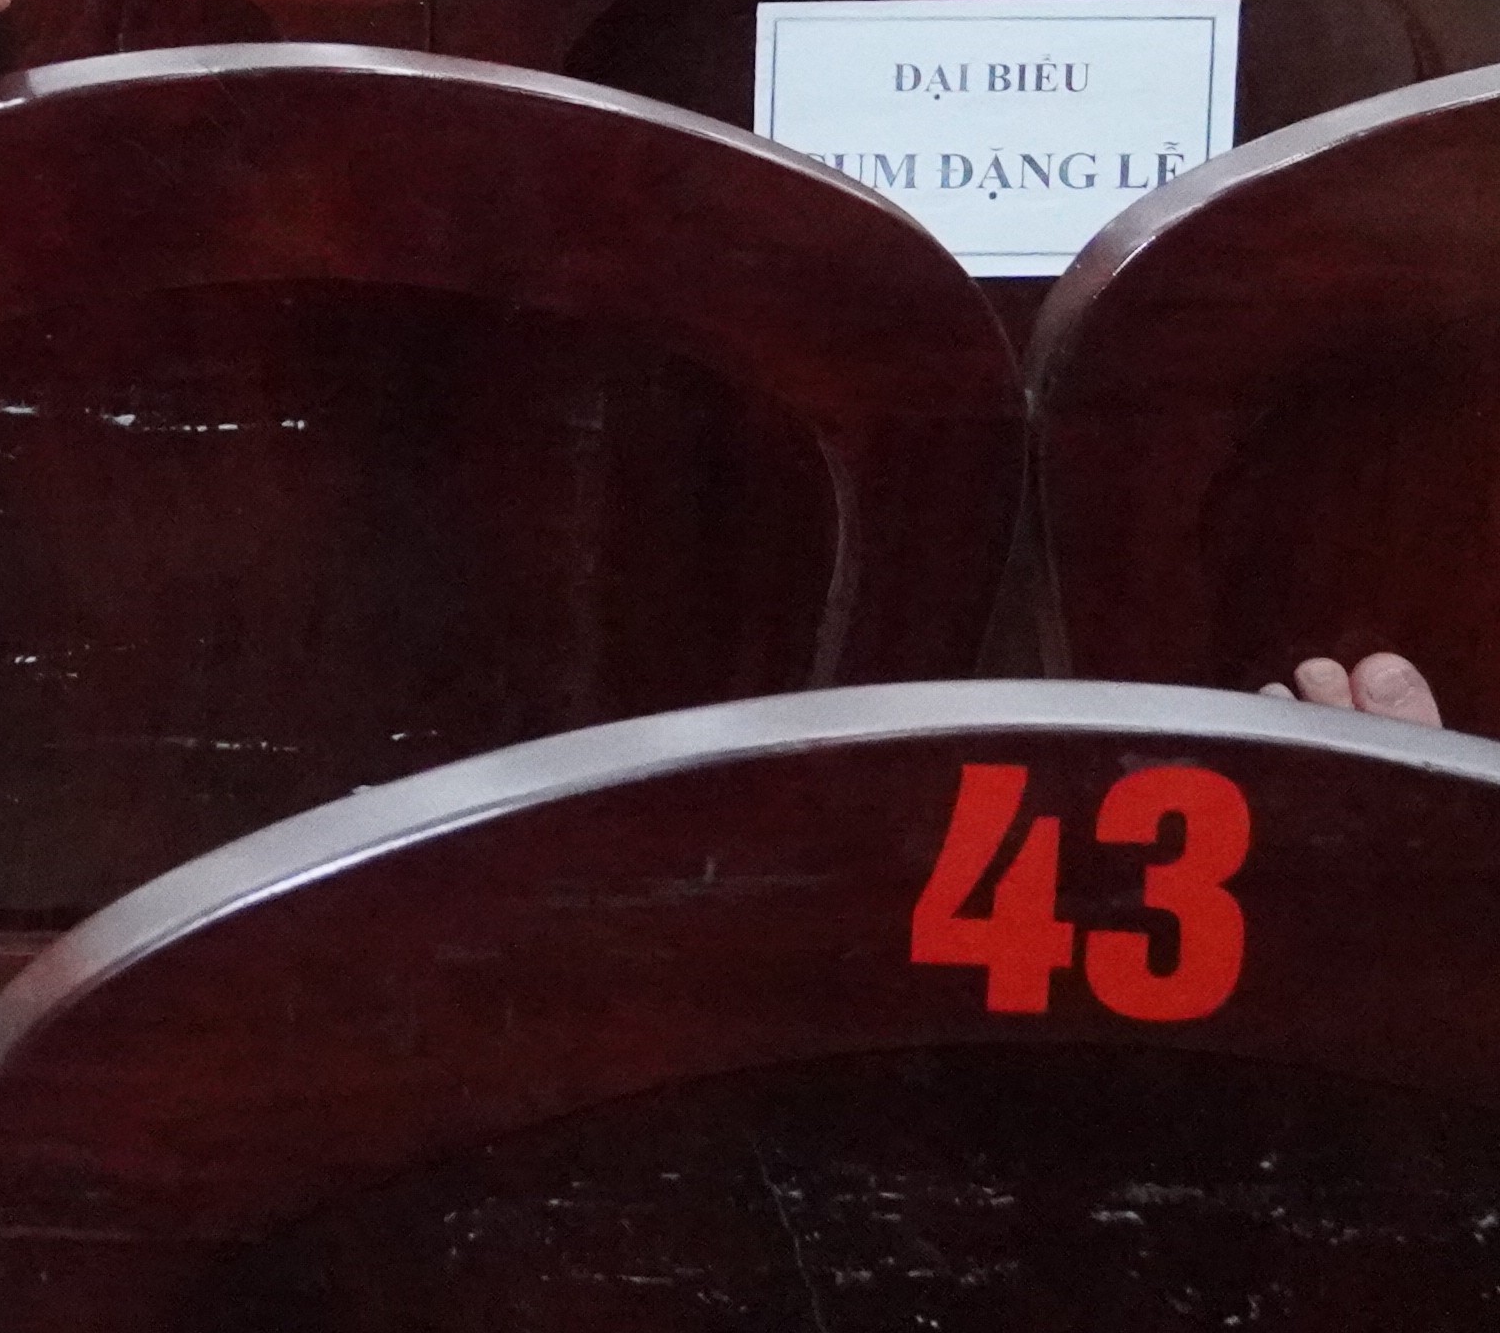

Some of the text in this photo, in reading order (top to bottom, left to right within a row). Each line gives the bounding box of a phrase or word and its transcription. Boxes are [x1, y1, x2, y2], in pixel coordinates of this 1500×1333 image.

[893, 54, 1090, 100] ĐẠI BIỂU
[936, 148, 1099, 200] ĐẶNG
[909, 764, 1251, 1020] 43
